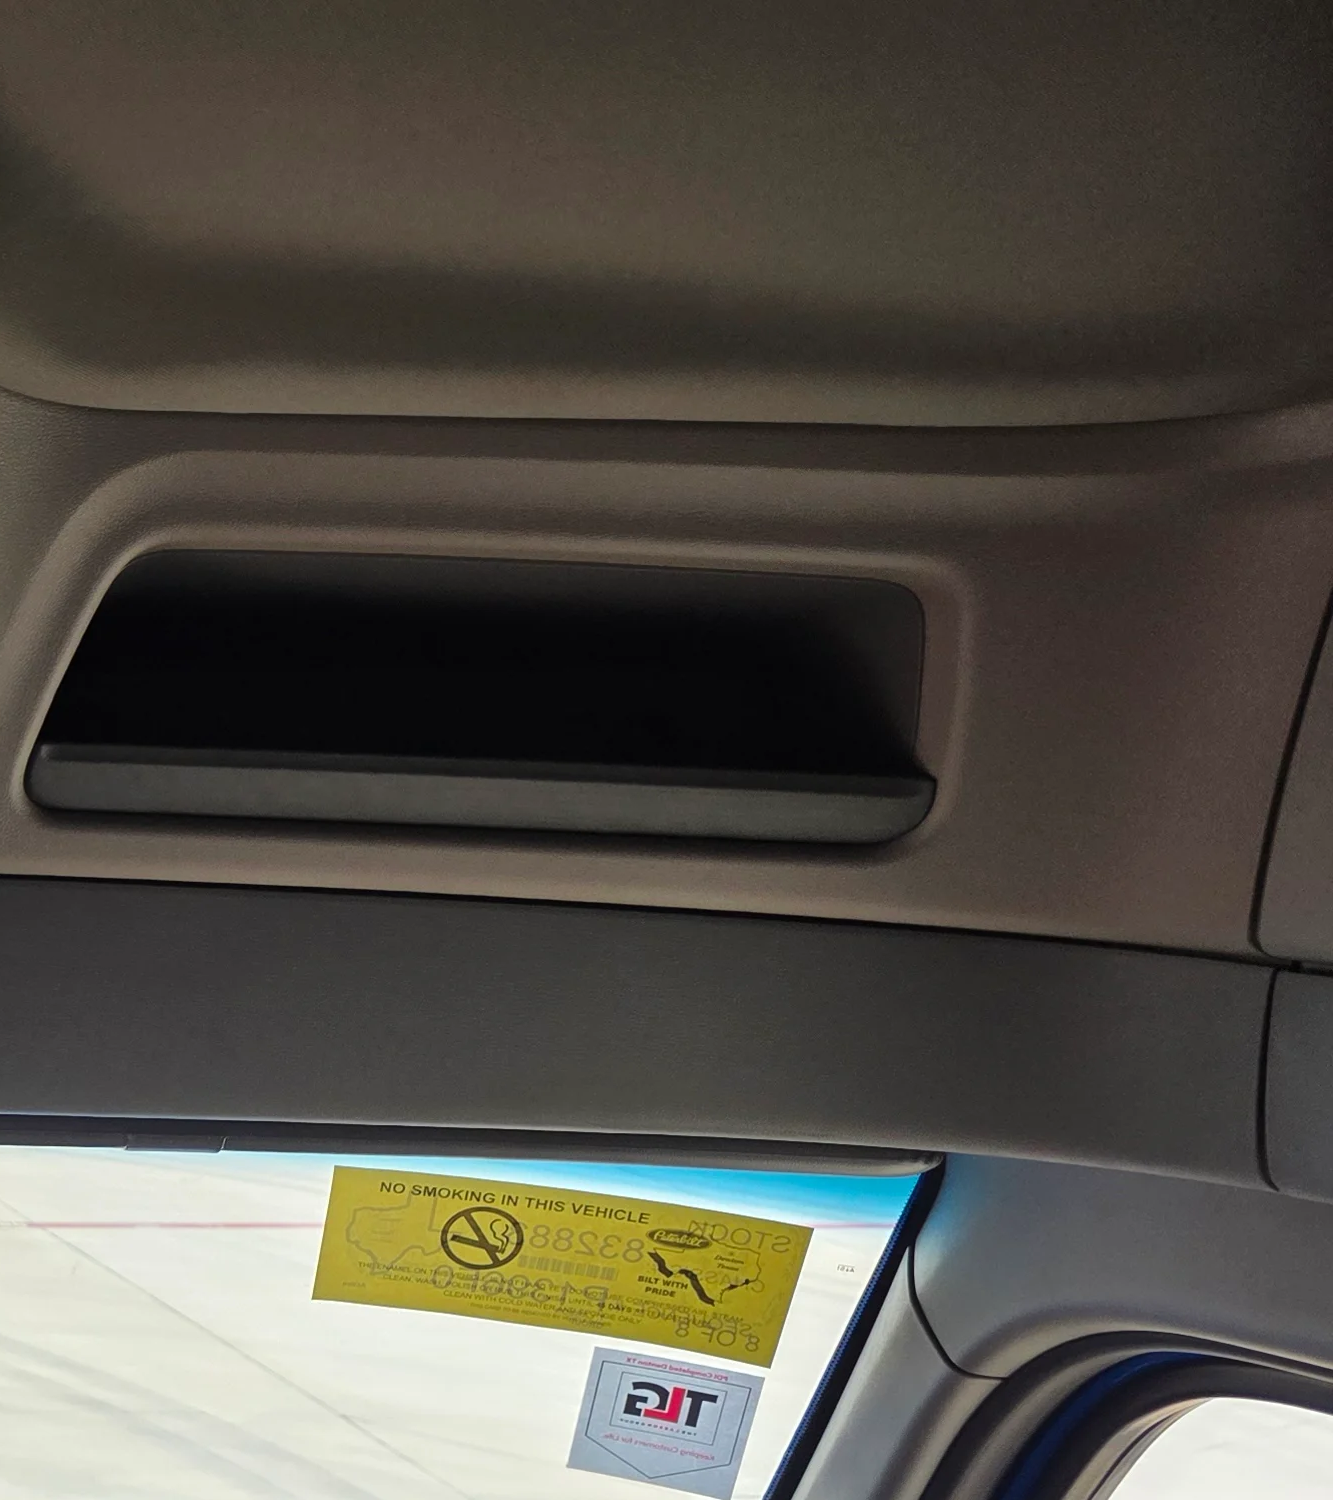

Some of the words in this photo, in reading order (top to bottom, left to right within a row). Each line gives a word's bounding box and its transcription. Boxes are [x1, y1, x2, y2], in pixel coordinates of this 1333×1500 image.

[380, 1181, 406, 1194] NO
[411, 1184, 496, 1204] SMOKING
[502, 1193, 519, 1207] IN
[525, 1197, 566, 1212] THIS
[571, 1203, 651, 1225] VEHICLE
[654, 1230, 702, 1248] Peterbilt
[636, 1274, 659, 1285] BILT
[660, 1278, 689, 1290] WITH
[644, 1285, 676, 1298] PRIDE
